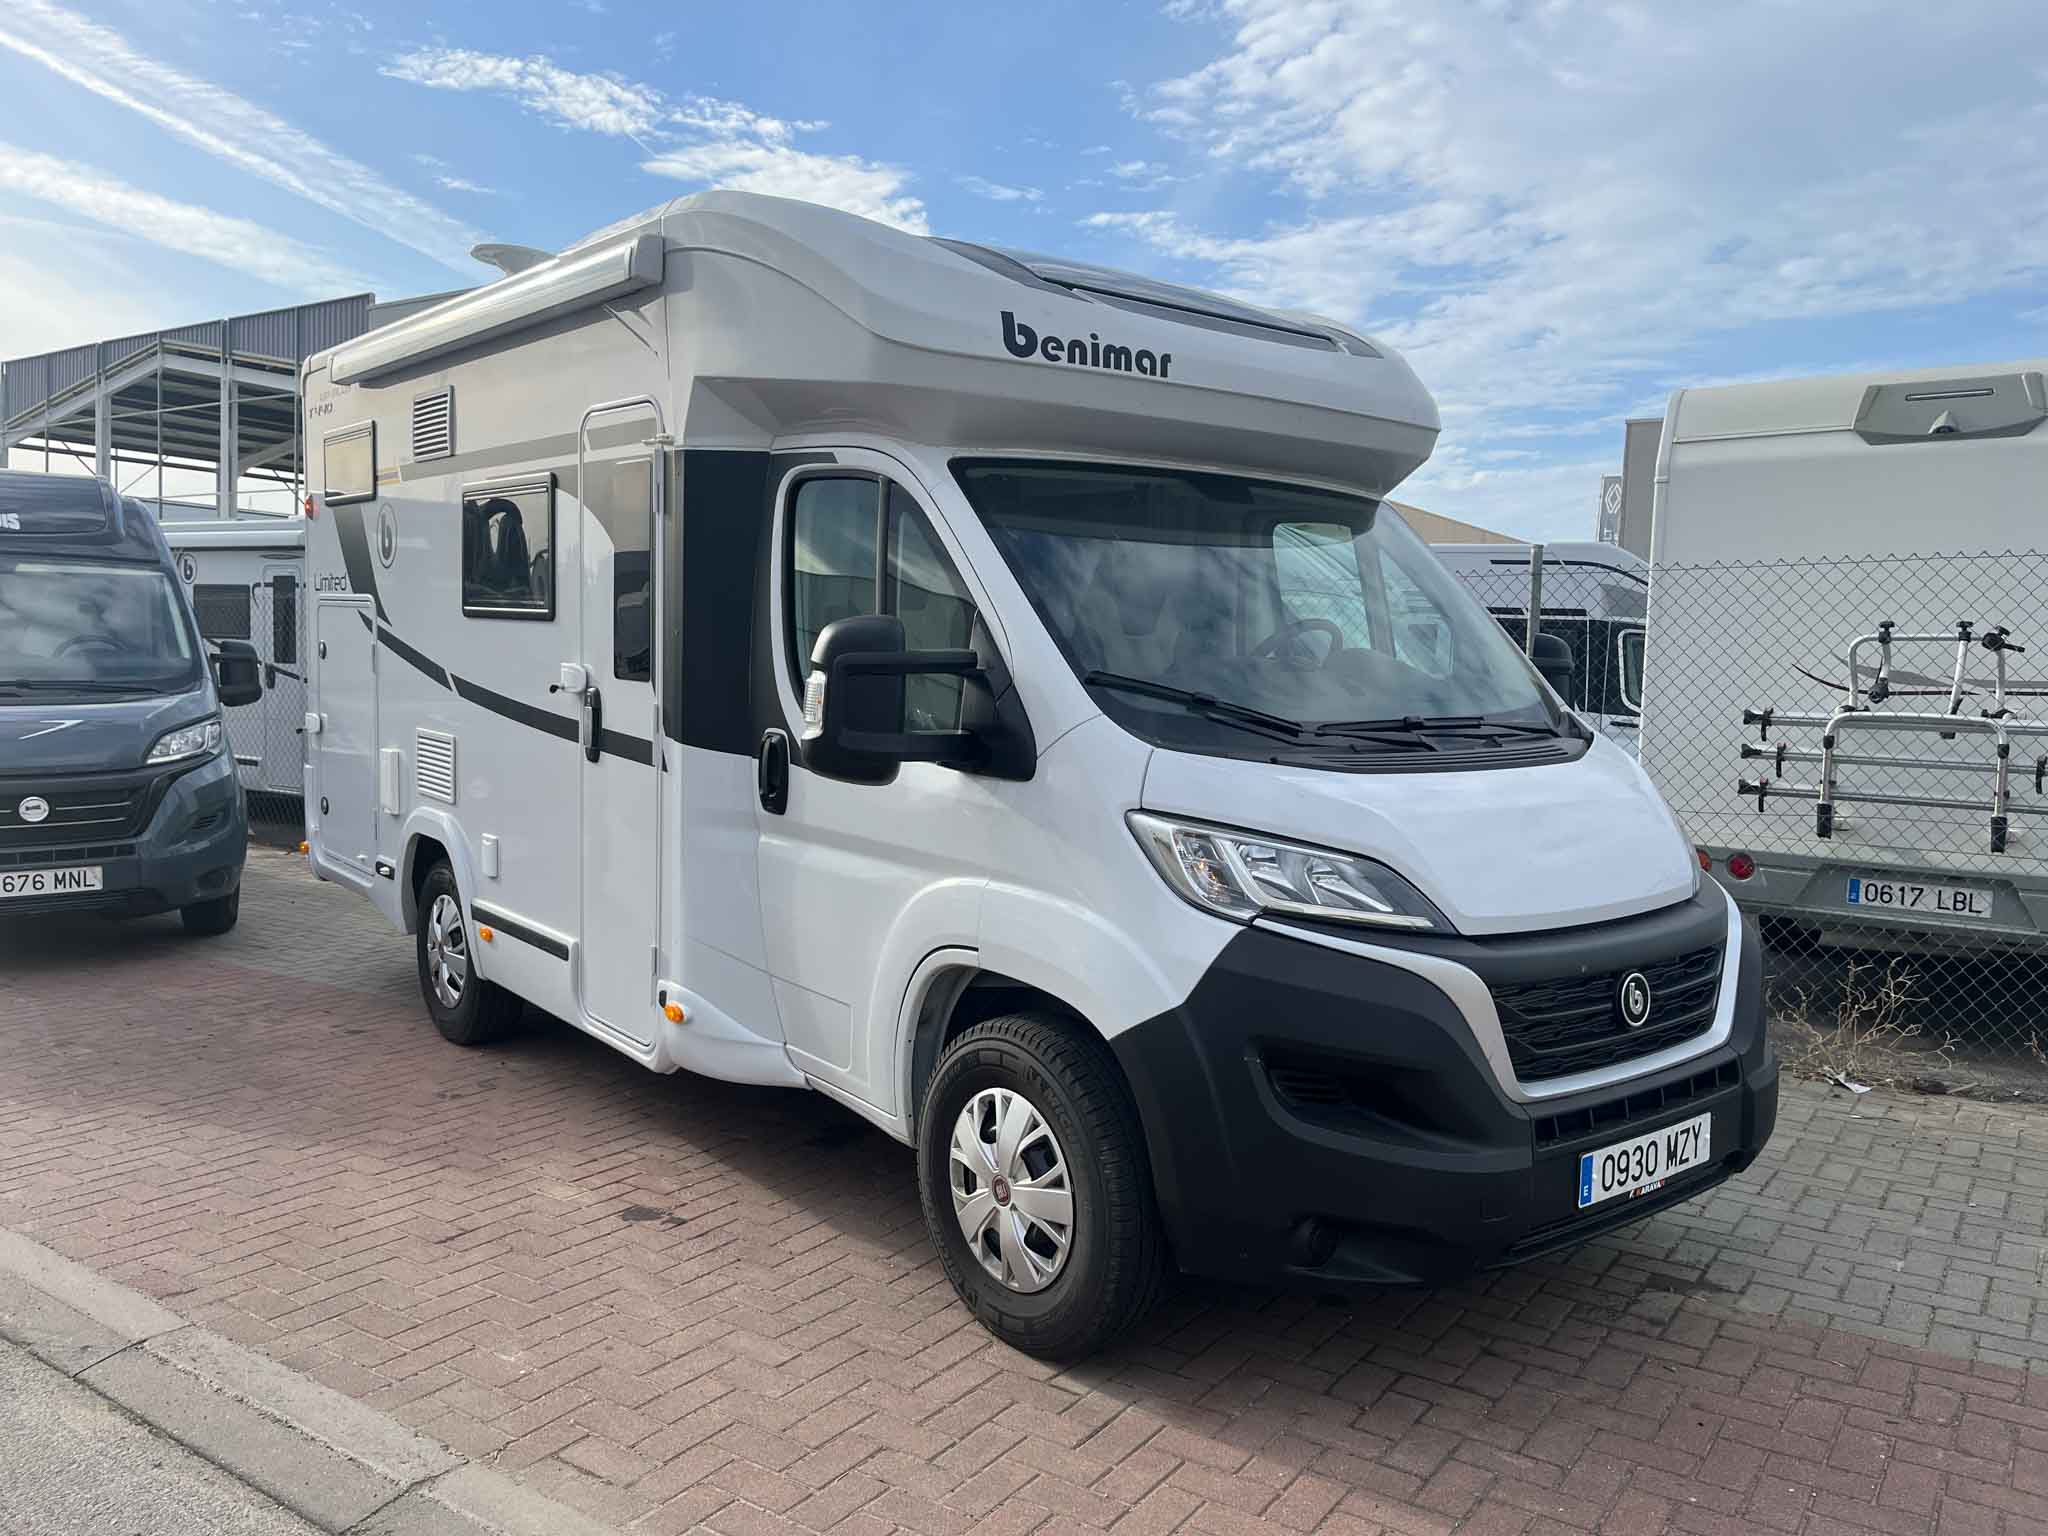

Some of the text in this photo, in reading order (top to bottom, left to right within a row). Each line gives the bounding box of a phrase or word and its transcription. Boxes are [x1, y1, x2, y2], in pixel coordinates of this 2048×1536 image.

[1000, 310, 1172, 378] benimar
[0, 512, 21, 530] IS
[313, 571, 347, 592] Limited
[2, 870, 96, 893] 676 MNL
[1864, 882, 1985, 914] 0617 LBL
[1583, 1122, 1702, 1196] E 0930 MZY
